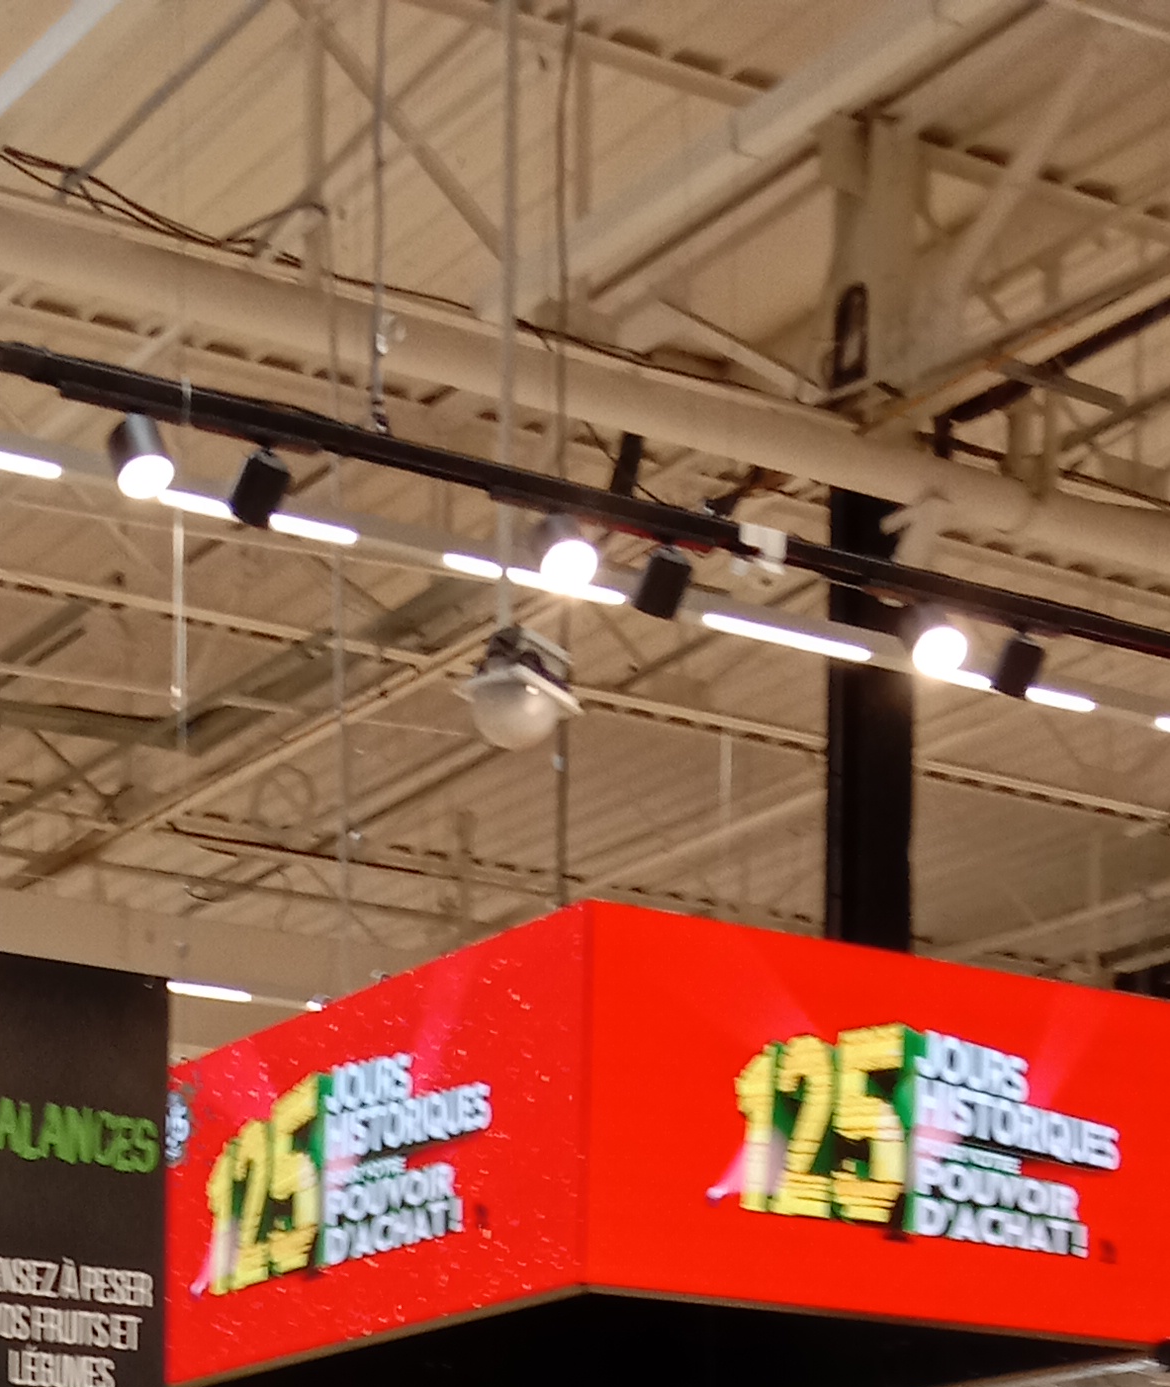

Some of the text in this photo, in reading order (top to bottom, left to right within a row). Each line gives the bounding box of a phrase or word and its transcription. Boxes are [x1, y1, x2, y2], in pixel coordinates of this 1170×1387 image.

[325, 1051, 414, 1115] JOURS
[915, 1030, 1029, 1102] JOURS
[324, 1082, 492, 1159] HISTORIQUES
[735, 1021, 908, 1224] 125
[915, 1079, 1121, 1170] HISTORIQUES
[324, 1162, 456, 1226] POUVOIR
[916, 1157, 1080, 1222] POUVOIR
[58, 1256, 81, 1301] À
[80, 1264, 155, 1308] PESER
[31, 1305, 111, 1346] FRUITS
[109, 1313, 145, 1351] ET
